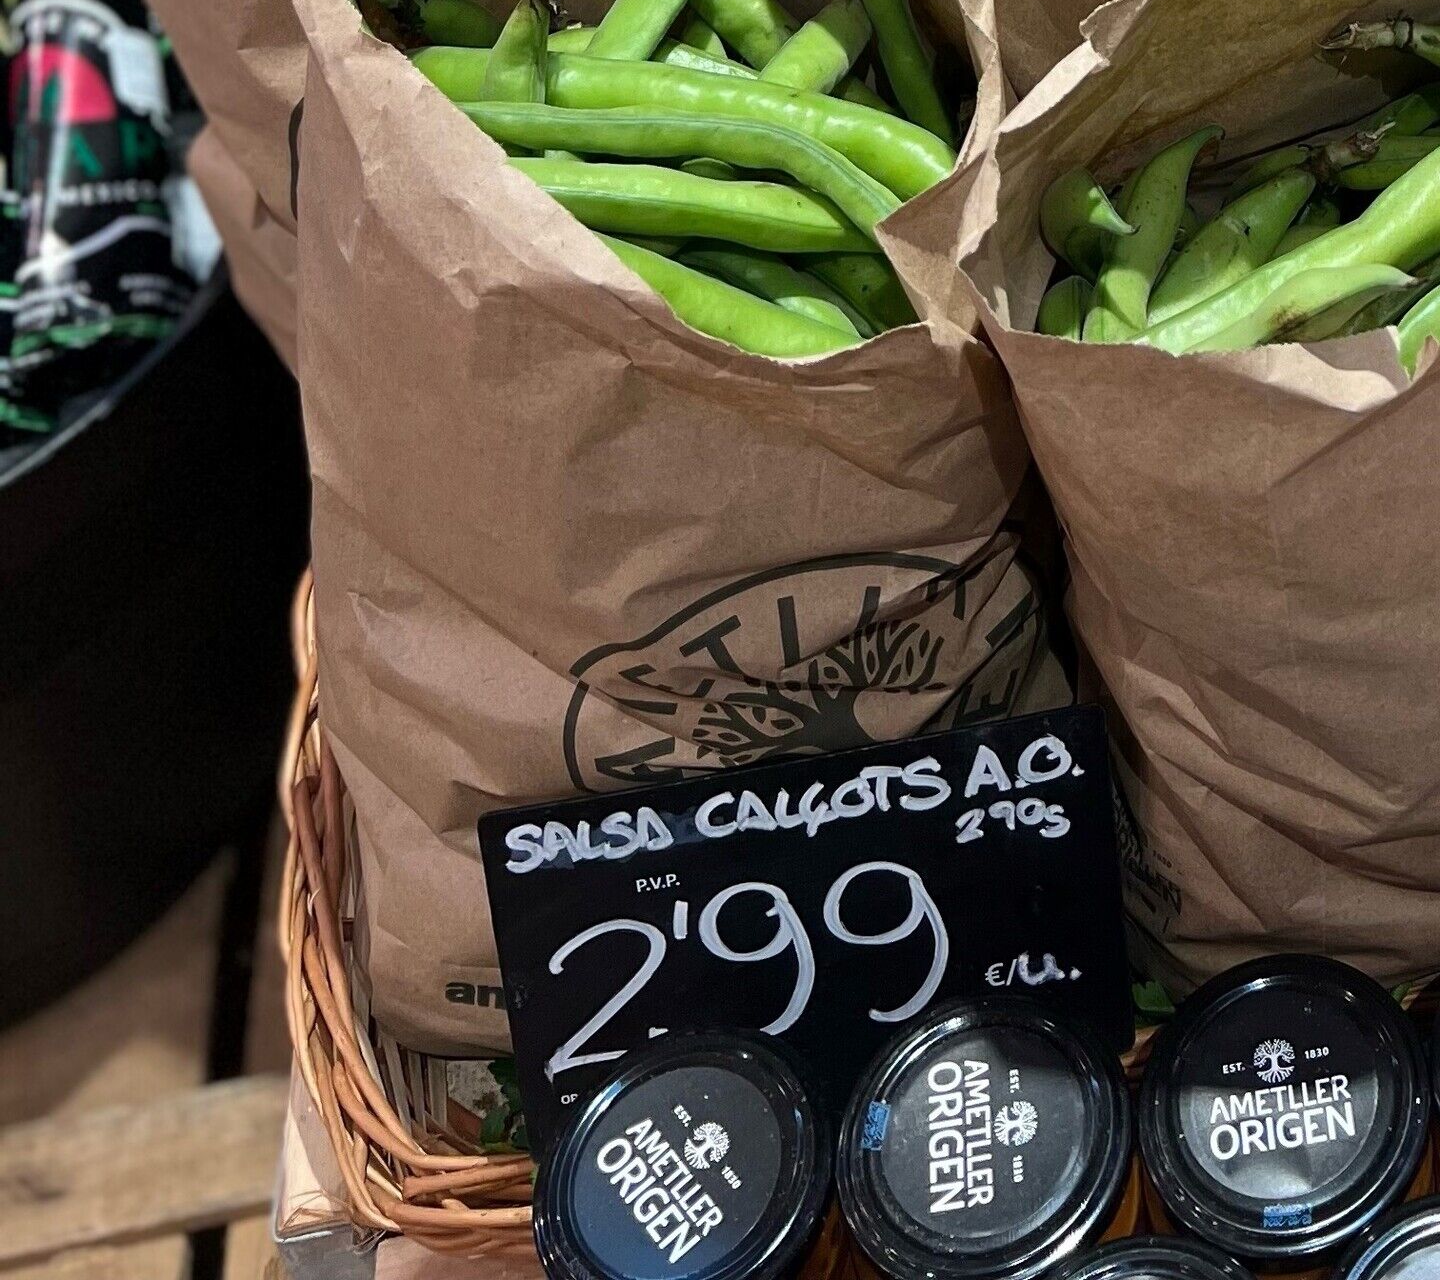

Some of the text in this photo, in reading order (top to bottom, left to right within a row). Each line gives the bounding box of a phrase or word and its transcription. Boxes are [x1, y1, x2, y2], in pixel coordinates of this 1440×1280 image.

[505, 806, 674, 873] SALSA
[964, 735, 1085, 798] A.O.
[635, 872, 681, 894] P.V.P.
[544, 861, 950, 1080] 2'99
[1008, 1068, 1020, 1093] EST.
[1209, 1074, 1351, 1124] AMETLLER
[1222, 1046, 1329, 1074] EST. 1830
[625, 1117, 723, 1237] AMETLLER
[673, 1104, 742, 1190] EST. 1830
[927, 1061, 965, 1213] ORIGEN
[963, 1059, 994, 1208] AMETLLER
[1209, 1101, 1356, 1160] ORIGEN
[597, 1138, 701, 1264] ORIGEN
